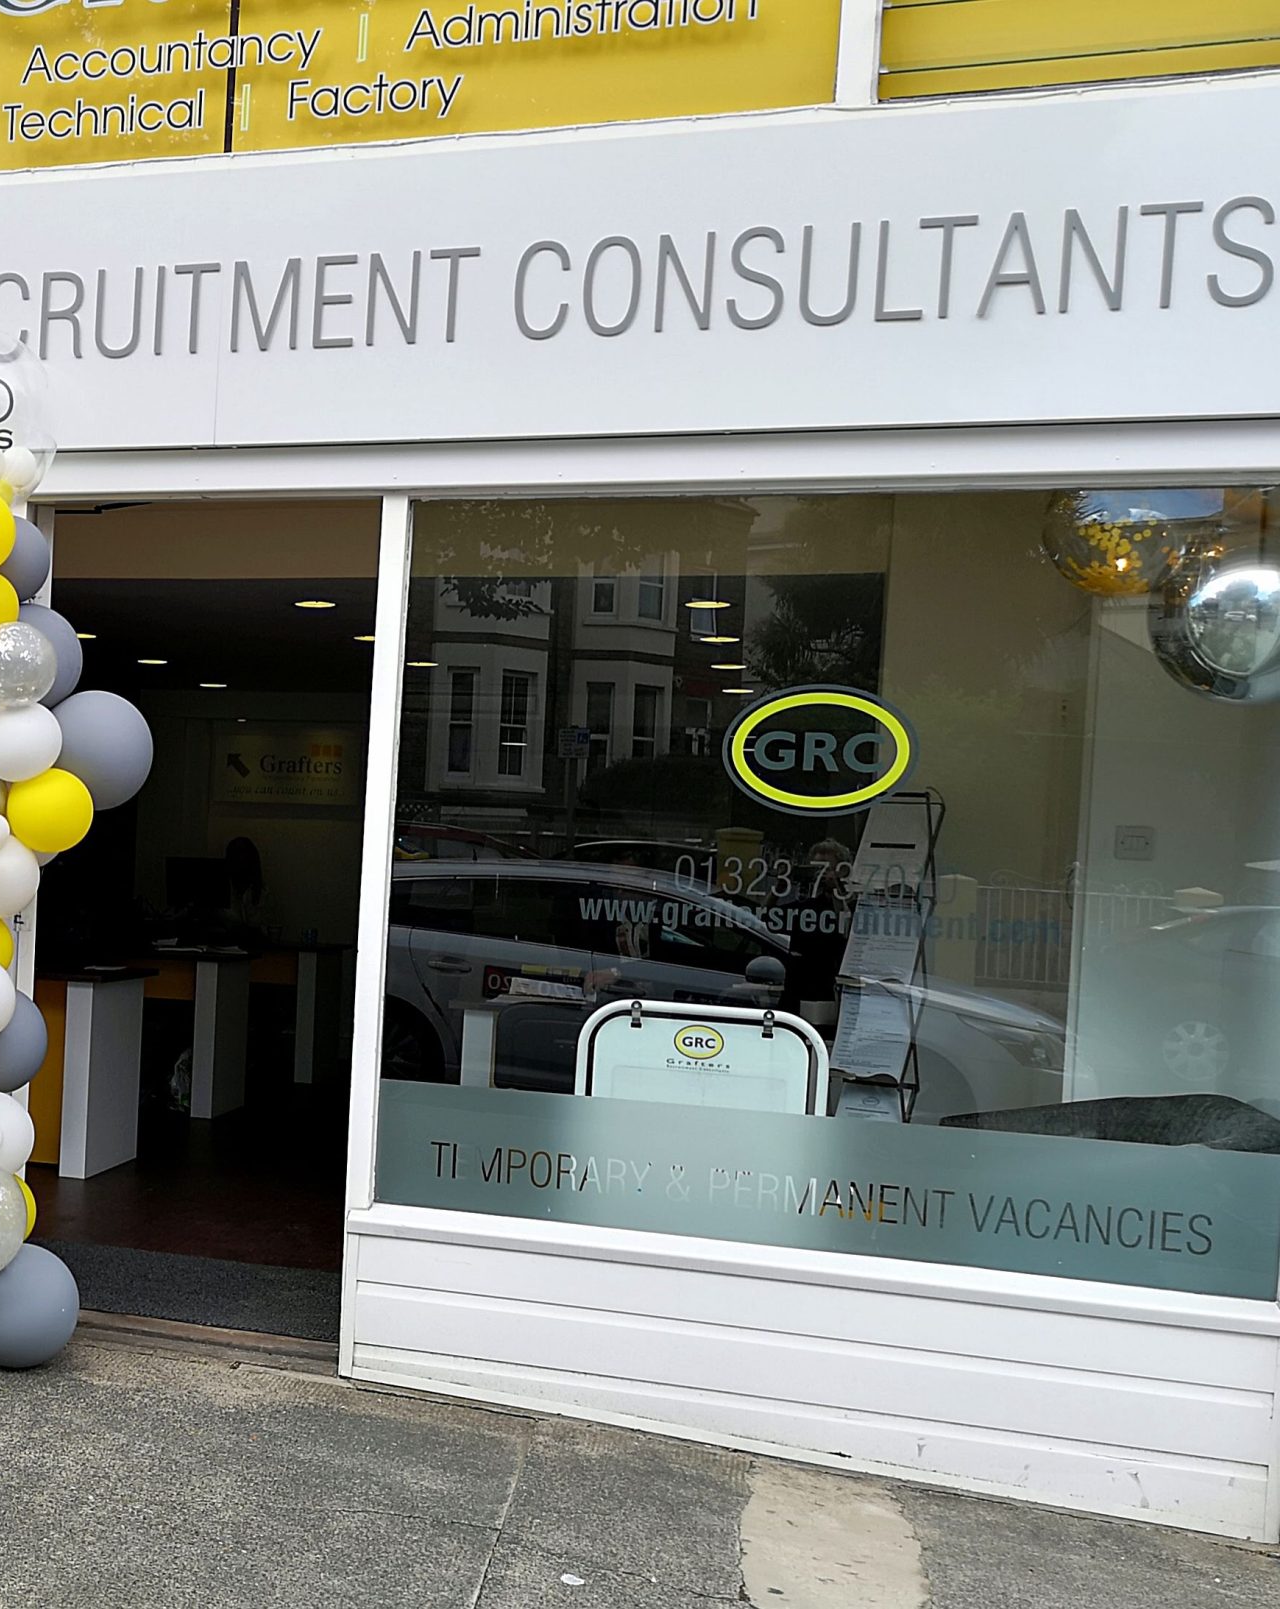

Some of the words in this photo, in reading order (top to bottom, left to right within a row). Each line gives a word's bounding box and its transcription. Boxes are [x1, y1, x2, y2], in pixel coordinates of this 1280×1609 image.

[21, 26, 323, 86] Accountancy
[404, 0, 758, 52] Administration
[3, 88, 206, 144] Technical
[287, 72, 464, 121] Factory
[514, 195, 1276, 340] CONSULTANTS
[260, 754, 343, 775] Grafters
[753, 730, 888, 773] GRC
[673, 854, 793, 898] 01323
[666, 1058, 731, 1069] Grafters
[682, 1036, 716, 1049] GRC
[430, 1140, 653, 1196] TEMPORARY
[665, 1163, 691, 1204] &
[708, 1166, 956, 1230] PERMANENT
[967, 1191, 1214, 1256] VACANCIES
